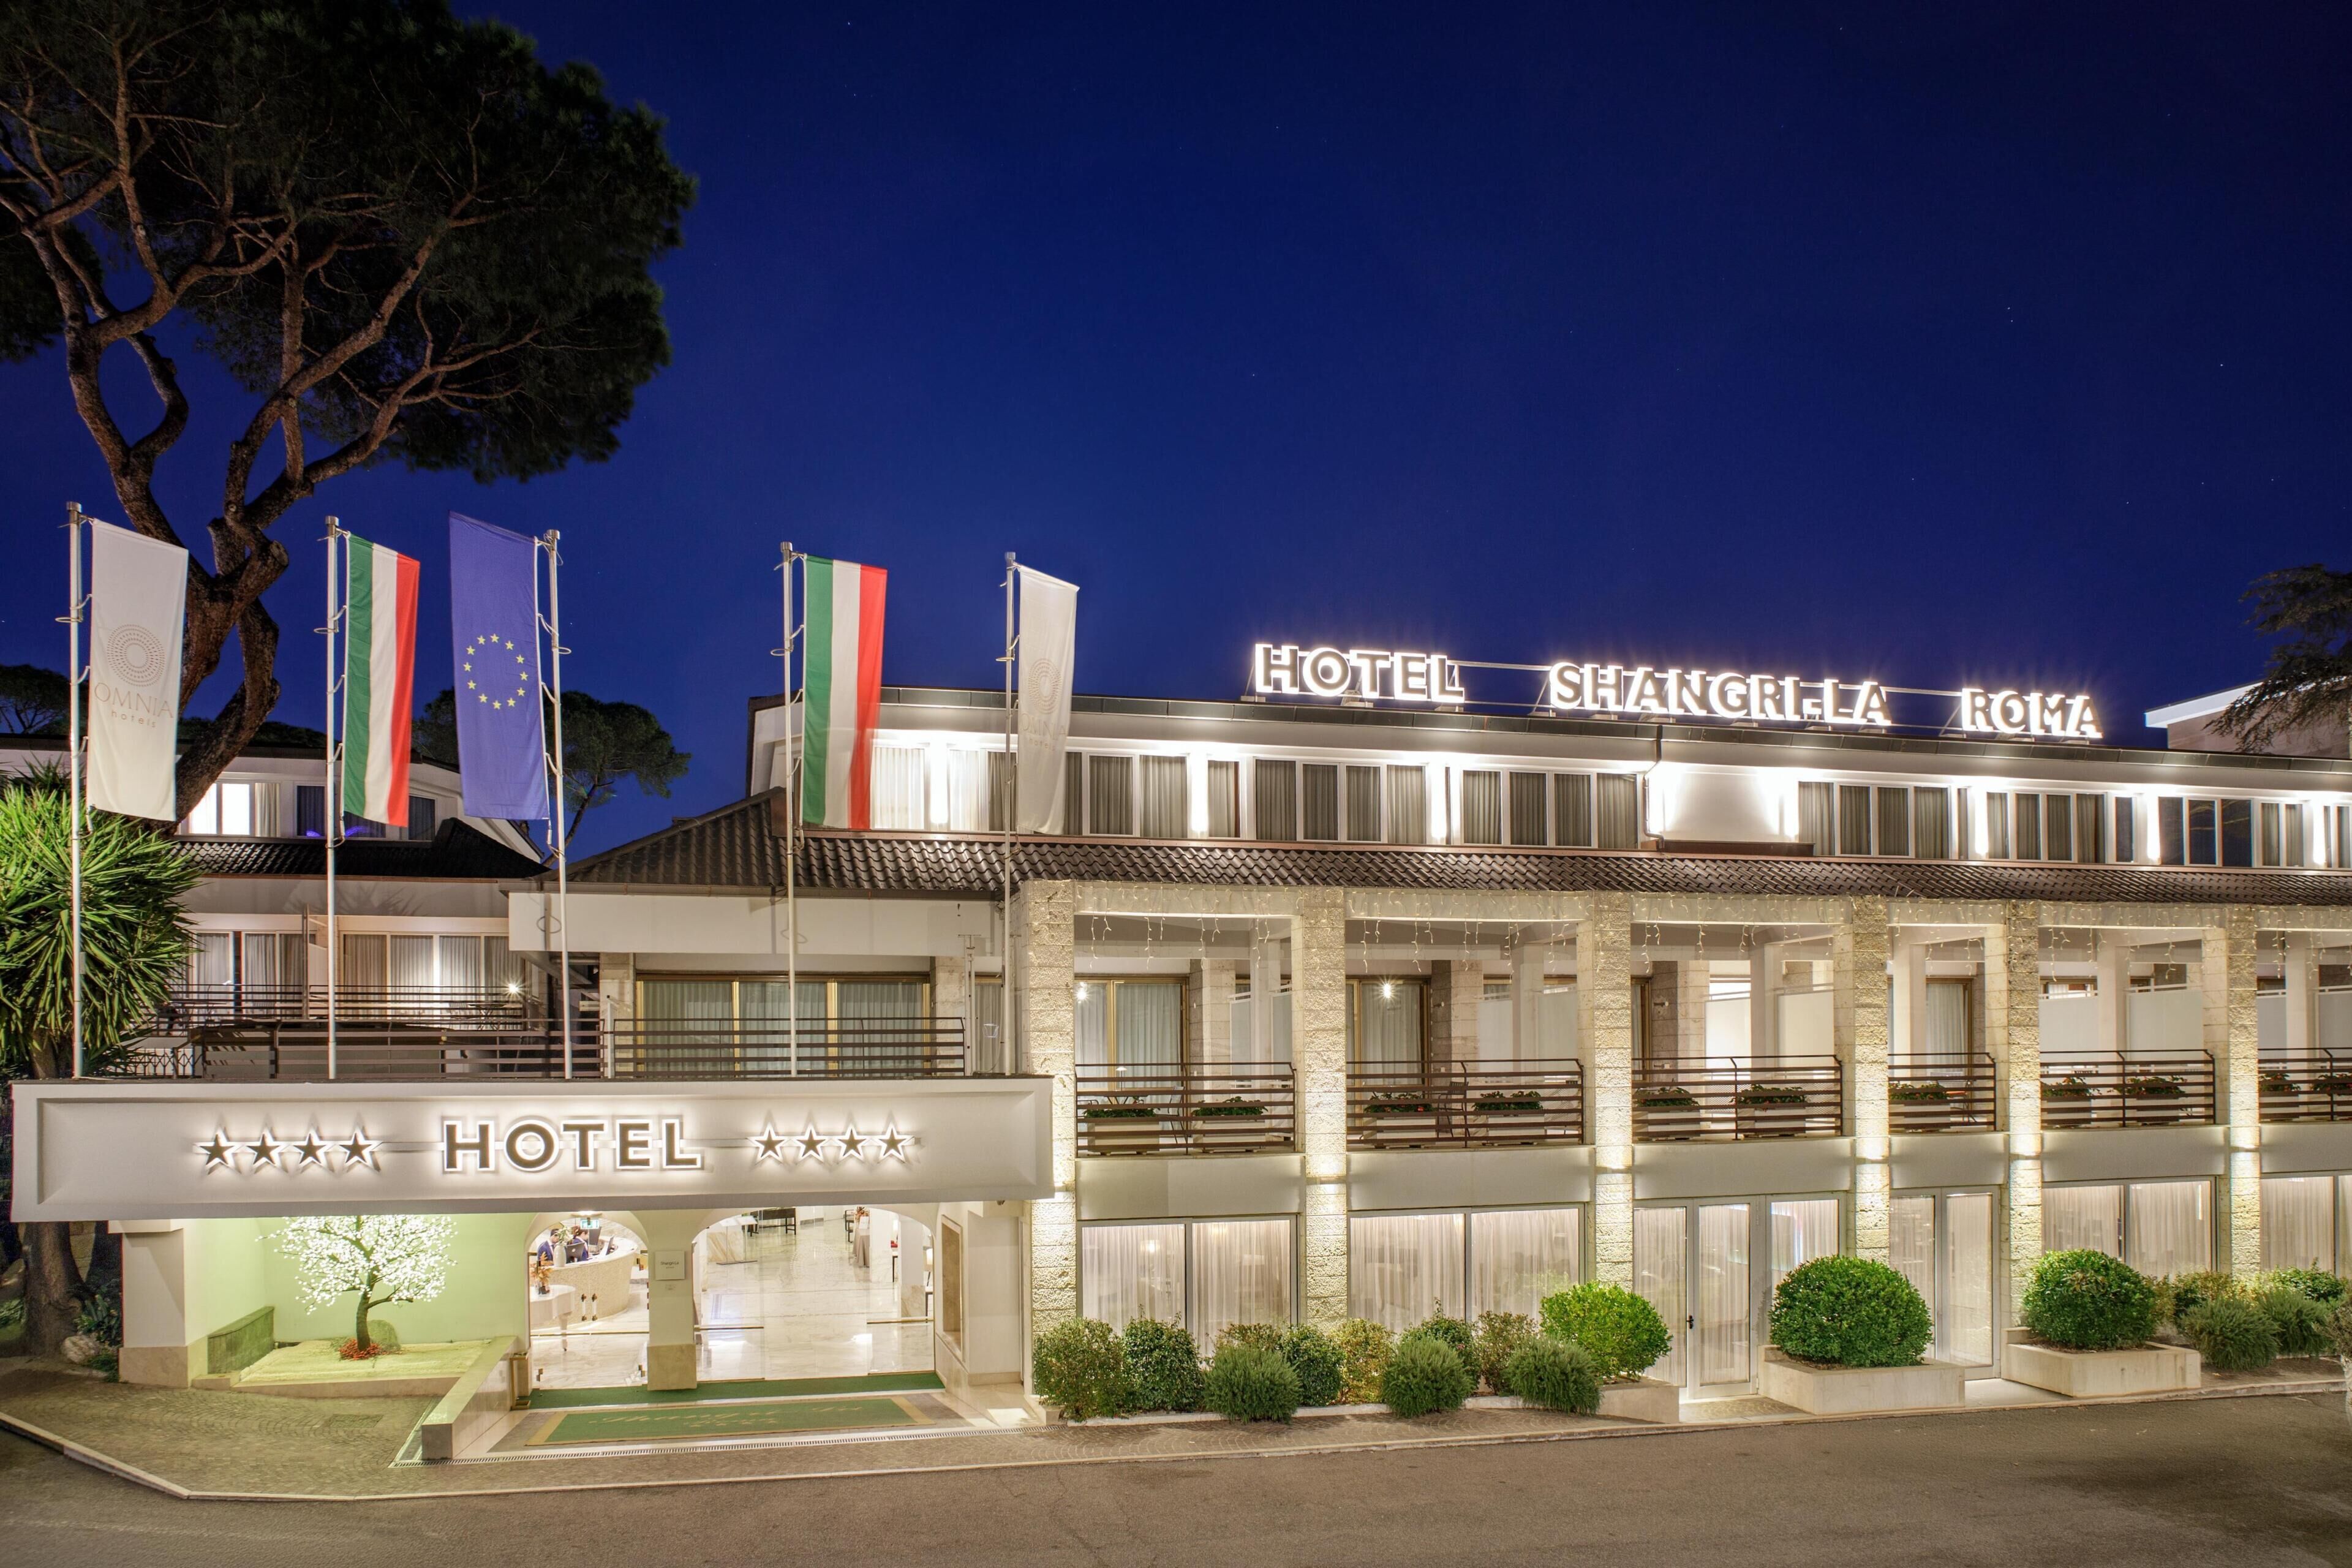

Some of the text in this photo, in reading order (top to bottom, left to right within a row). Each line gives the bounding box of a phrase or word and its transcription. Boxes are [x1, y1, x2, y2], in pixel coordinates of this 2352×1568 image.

[94, 682, 174, 718] OMNIA
[1255, 643, 2103, 739] HOTEL SHANGRI-LA ROMA
[111, 709, 157, 728] hotels
[442, 1118, 703, 1172] HOTEL
